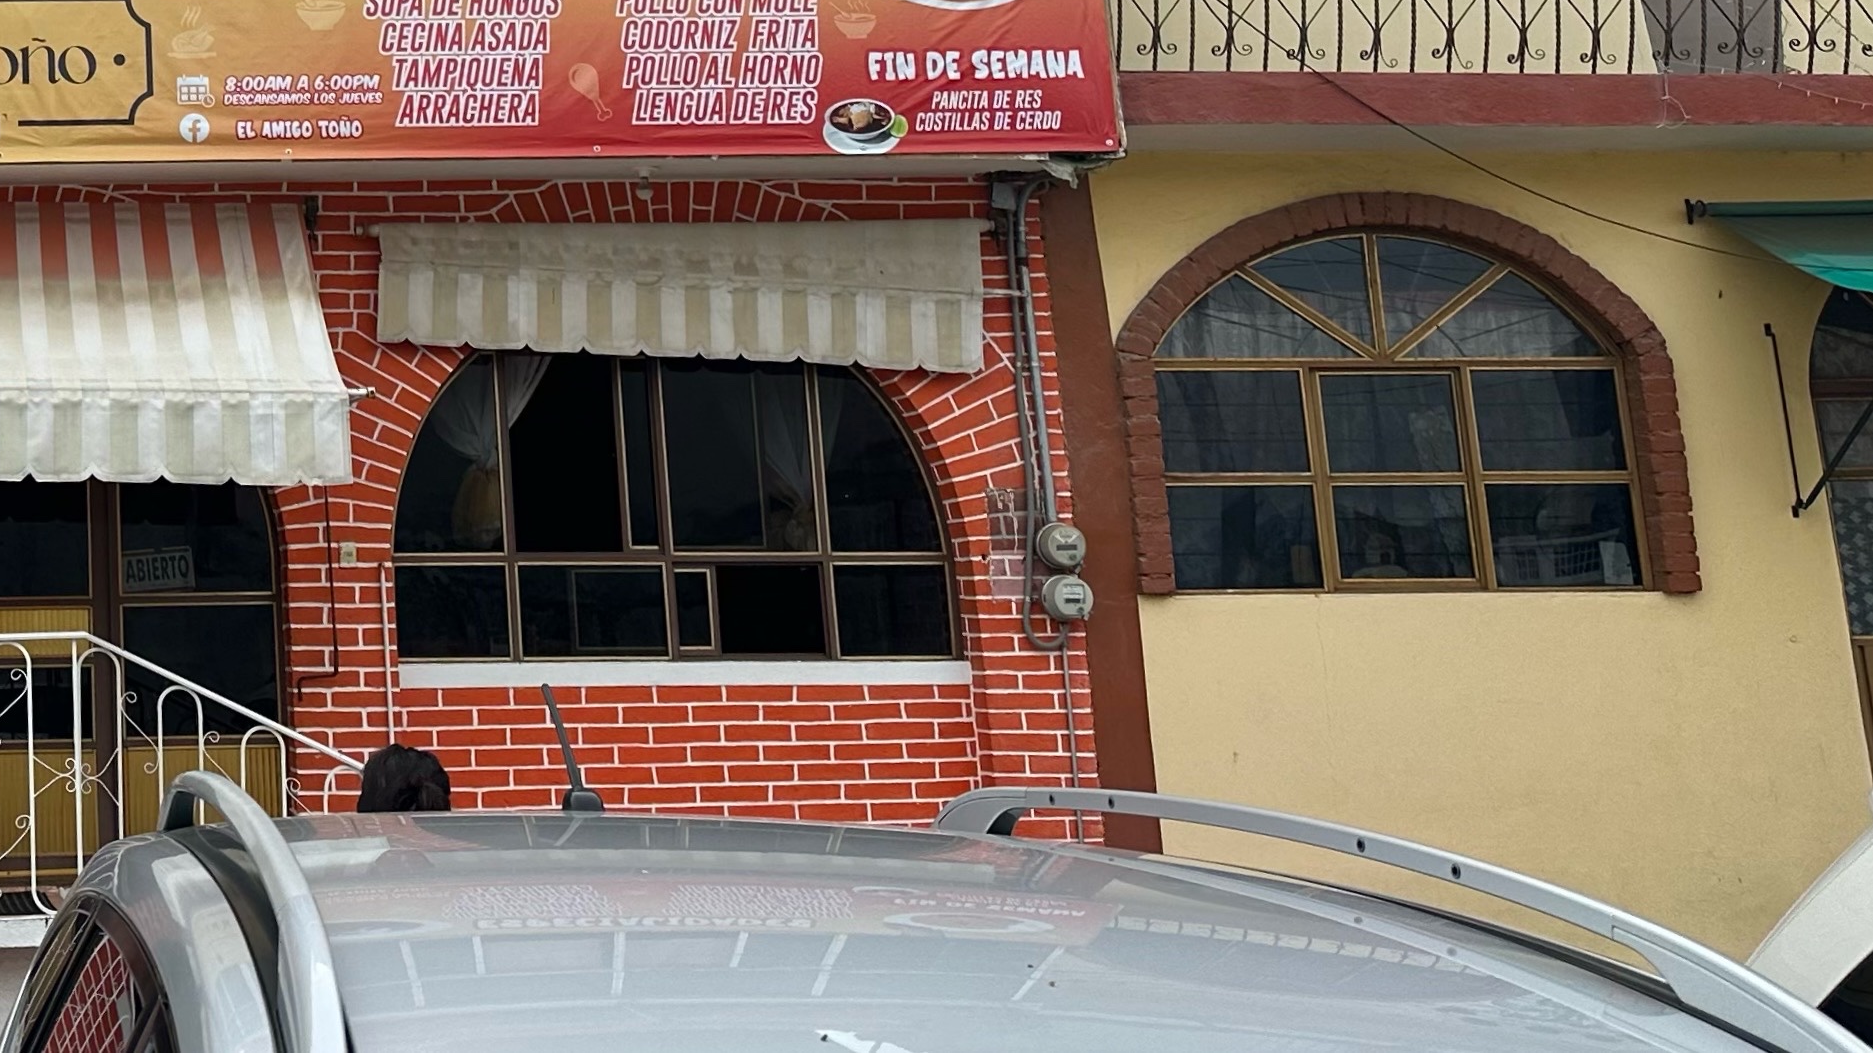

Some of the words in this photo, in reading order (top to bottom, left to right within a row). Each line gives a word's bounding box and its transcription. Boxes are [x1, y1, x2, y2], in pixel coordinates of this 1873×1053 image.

[380, 21, 464, 53] CECINA
[470, 20, 549, 52] ASADA
[621, 18, 739, 51] CODORNIZ
[750, 18, 817, 50] FRITA
[393, 54, 542, 90] TAMPIQUEÑA
[624, 54, 699, 88] POLLO
[703, 54, 735, 87] AL
[740, 53, 822, 87] HORNO
[867, 51, 916, 81] FIN
[925, 50, 962, 81] DE
[970, 48, 1086, 79] SEMANA
[223, 92, 311, 106] DESCANSAMOS
[313, 92, 336, 105] LOS
[338, 91, 383, 104] JUEVES
[225, 75, 293, 92] 8:00AM
[297, 75, 310, 91] A
[313, 74, 381, 91] 6:00PM
[931, 90, 989, 110] PANCITA
[992, 89, 1015, 109] DE
[1014, 89, 1043, 109] RES
[397, 92, 539, 126] ARRACHERA
[633, 90, 726, 124] LENGUA
[730, 90, 765, 123] DE
[768, 89, 818, 122] RES
[914, 111, 991, 132] COSTILLAS
[993, 111, 1014, 131] DE
[1015, 110, 1062, 131] CERDO
[236, 120, 258, 139] EL
[261, 120, 314, 139] AMIGO
[318, 116, 363, 138] TOÑO
[125, 554, 190, 585] ABIERTO
